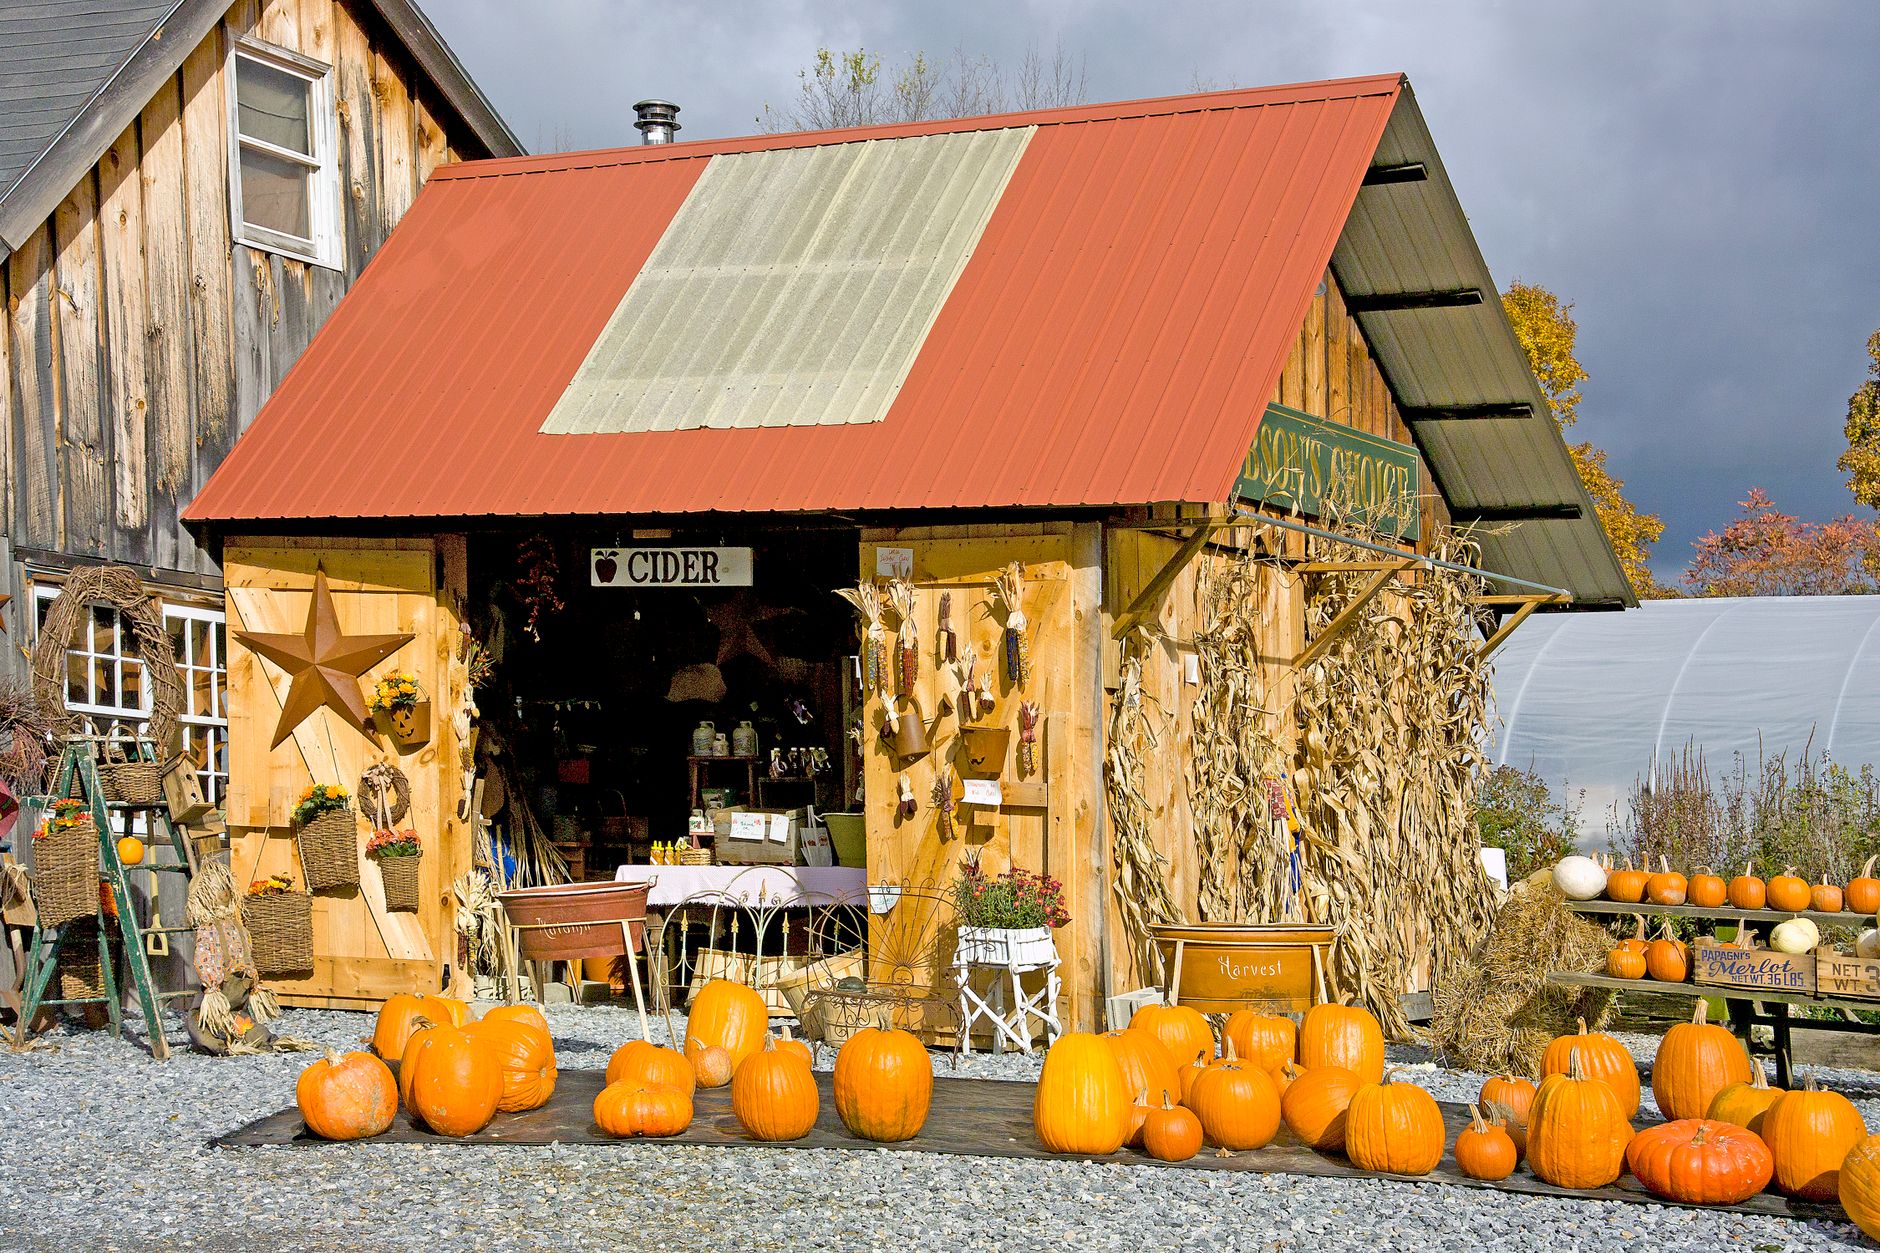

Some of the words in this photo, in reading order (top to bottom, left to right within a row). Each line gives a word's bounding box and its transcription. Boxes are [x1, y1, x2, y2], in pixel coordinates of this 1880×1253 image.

[627, 551, 720, 584] CIDER
[1701, 949, 1751, 962] PAPAGNI'S
[1217, 955, 1283, 980] Harvest
[1708, 958, 1794, 977] Merlot
[1832, 963, 1862, 977] NET
[1731, 974, 1749, 983] NET
[1749, 974, 1766, 985] WT.
[1767, 973, 1782, 986] 36
[1834, 978, 1862, 992] WT.
